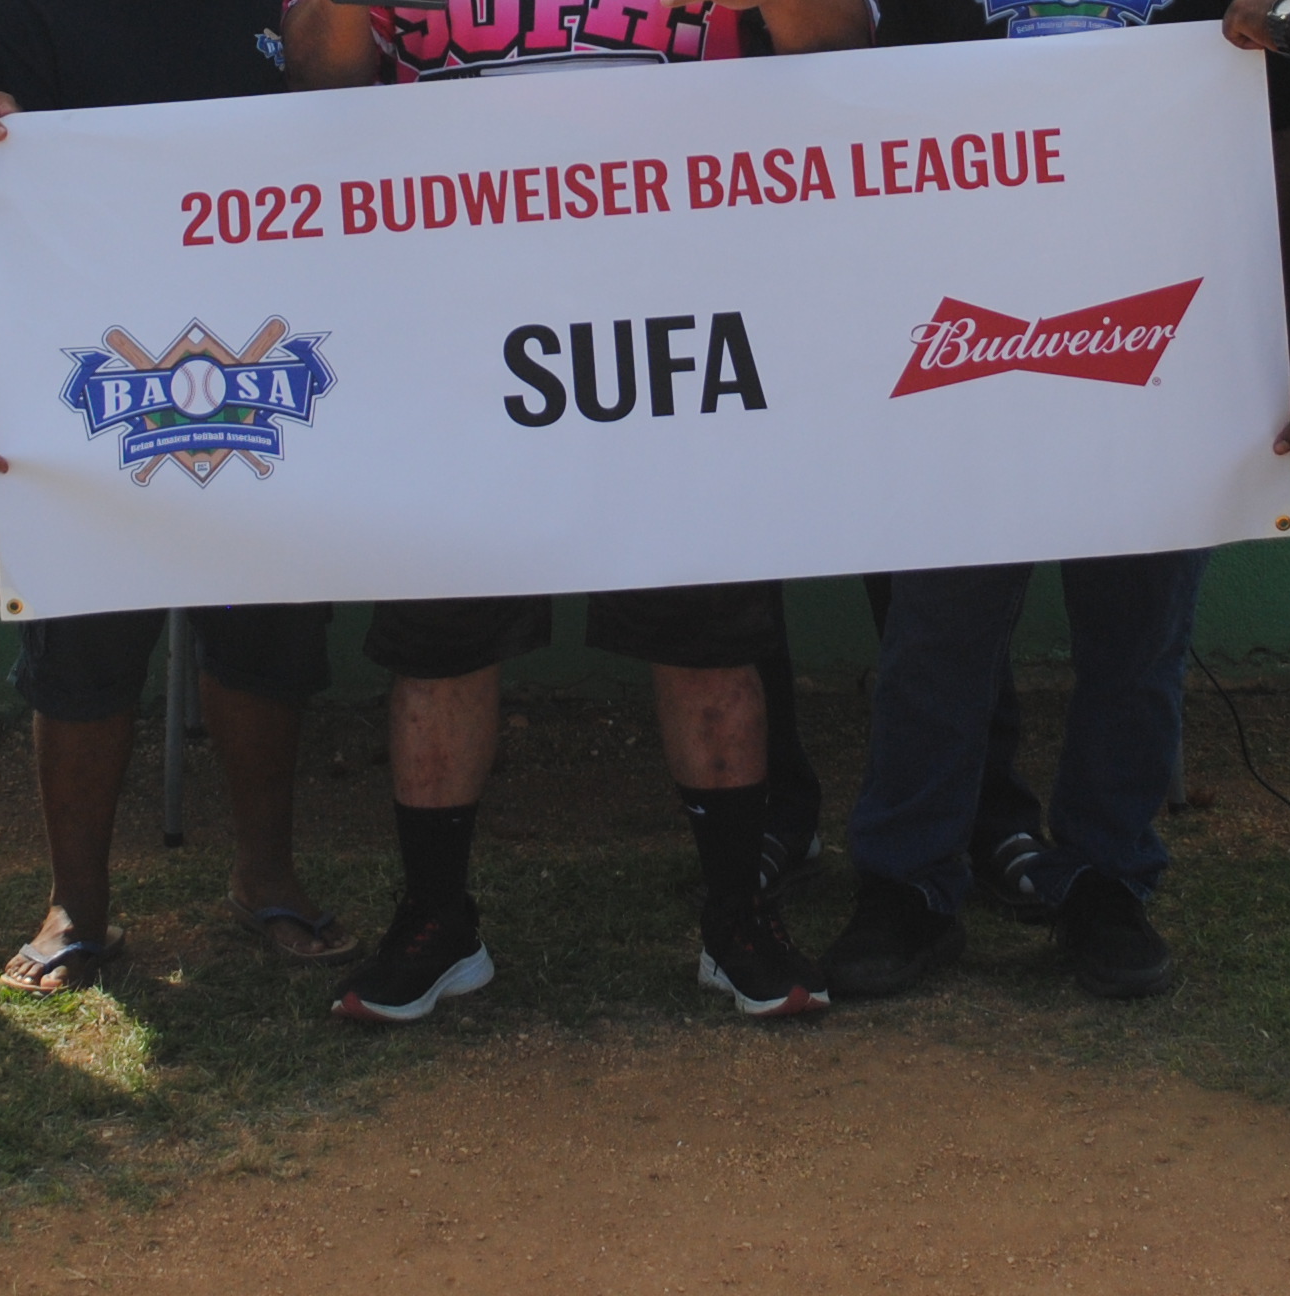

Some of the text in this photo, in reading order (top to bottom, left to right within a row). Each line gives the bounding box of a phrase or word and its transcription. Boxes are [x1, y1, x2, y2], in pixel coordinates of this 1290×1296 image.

[181, 128, 1065, 247] 2022 BUDWEISER BASA LEAGUE
[503, 311, 768, 428] SUFA
[909, 315, 1177, 370] Budweiser
